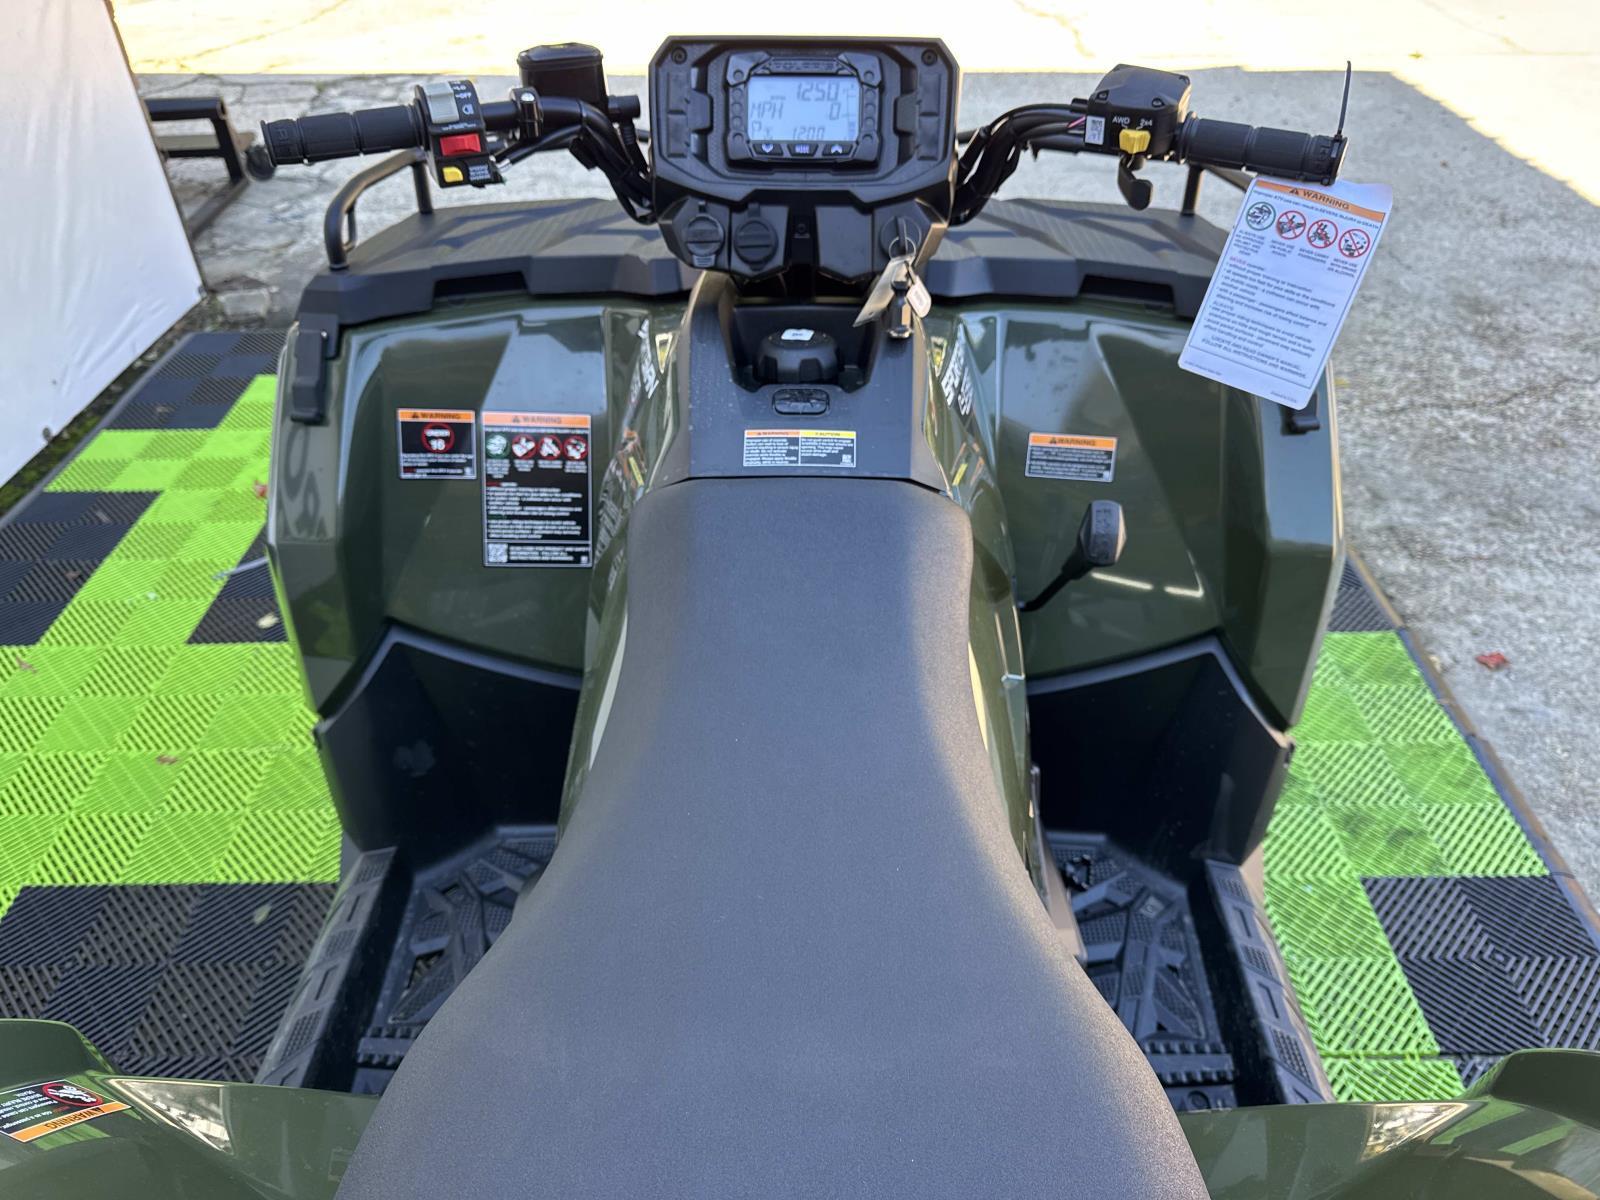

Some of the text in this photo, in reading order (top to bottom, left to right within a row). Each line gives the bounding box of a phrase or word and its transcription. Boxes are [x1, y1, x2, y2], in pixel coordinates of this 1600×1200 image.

[797, 79, 840, 101] 1250
[750, 101, 842, 121] MPH 0
[1112, 116, 1153, 127] AWD 2x4
[1301, 191, 1352, 210] WARNING
[421, 412, 461, 420] WARNING
[523, 416, 562, 424] WARNING
[43, 1109, 95, 1129] WARNING
